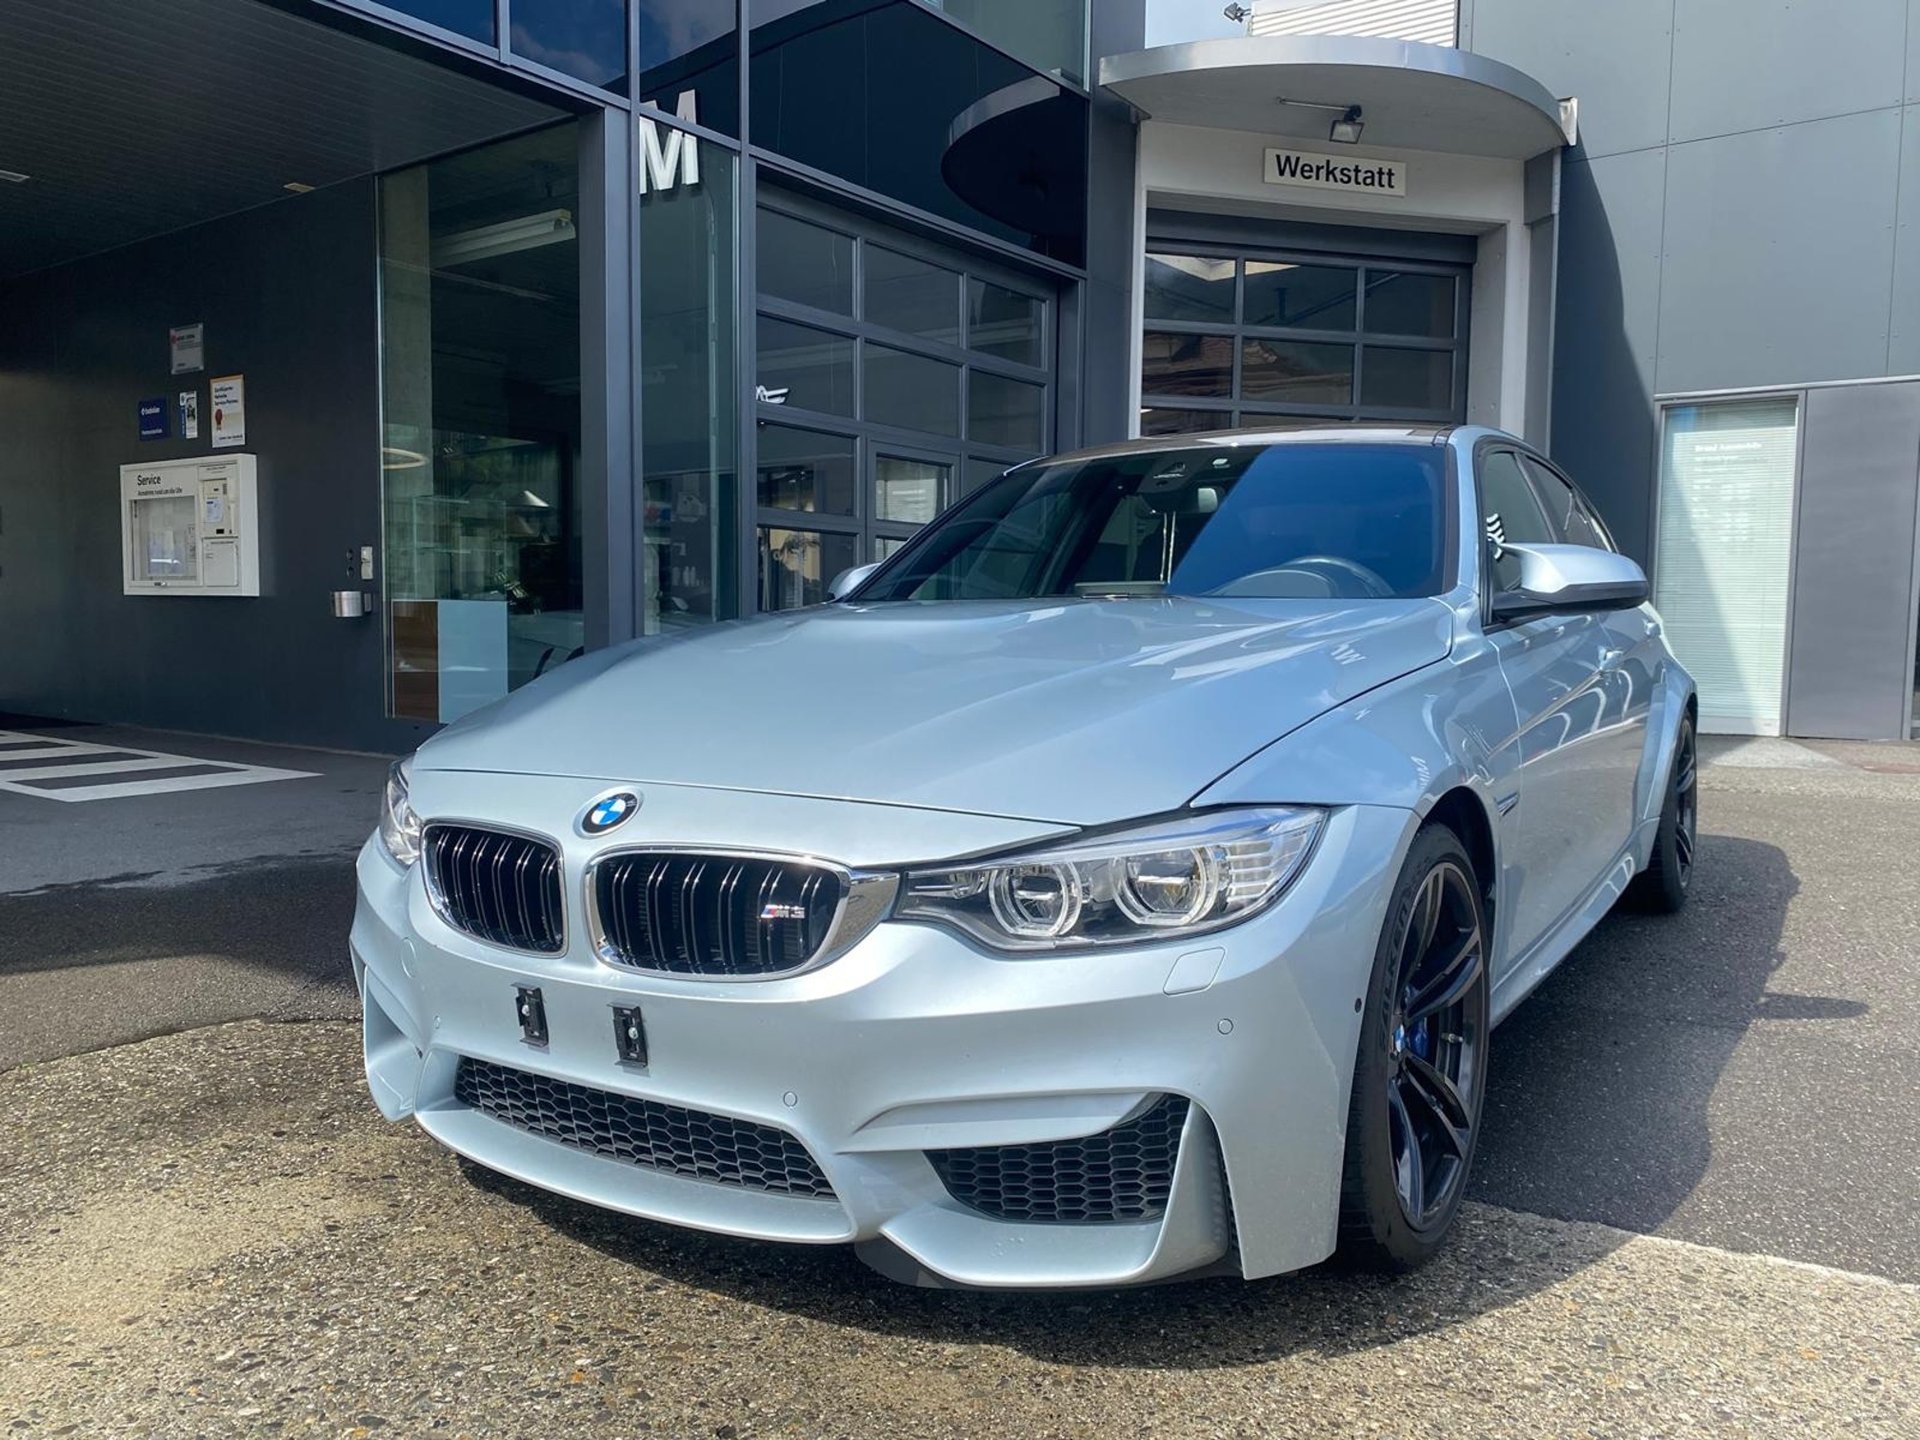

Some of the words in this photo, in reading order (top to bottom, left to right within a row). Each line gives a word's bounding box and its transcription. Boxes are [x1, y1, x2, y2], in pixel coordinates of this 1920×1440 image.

[1275, 153, 1395, 189] Werkstatt
[137, 474, 162, 486] Service
[770, 904, 806, 919] M3
